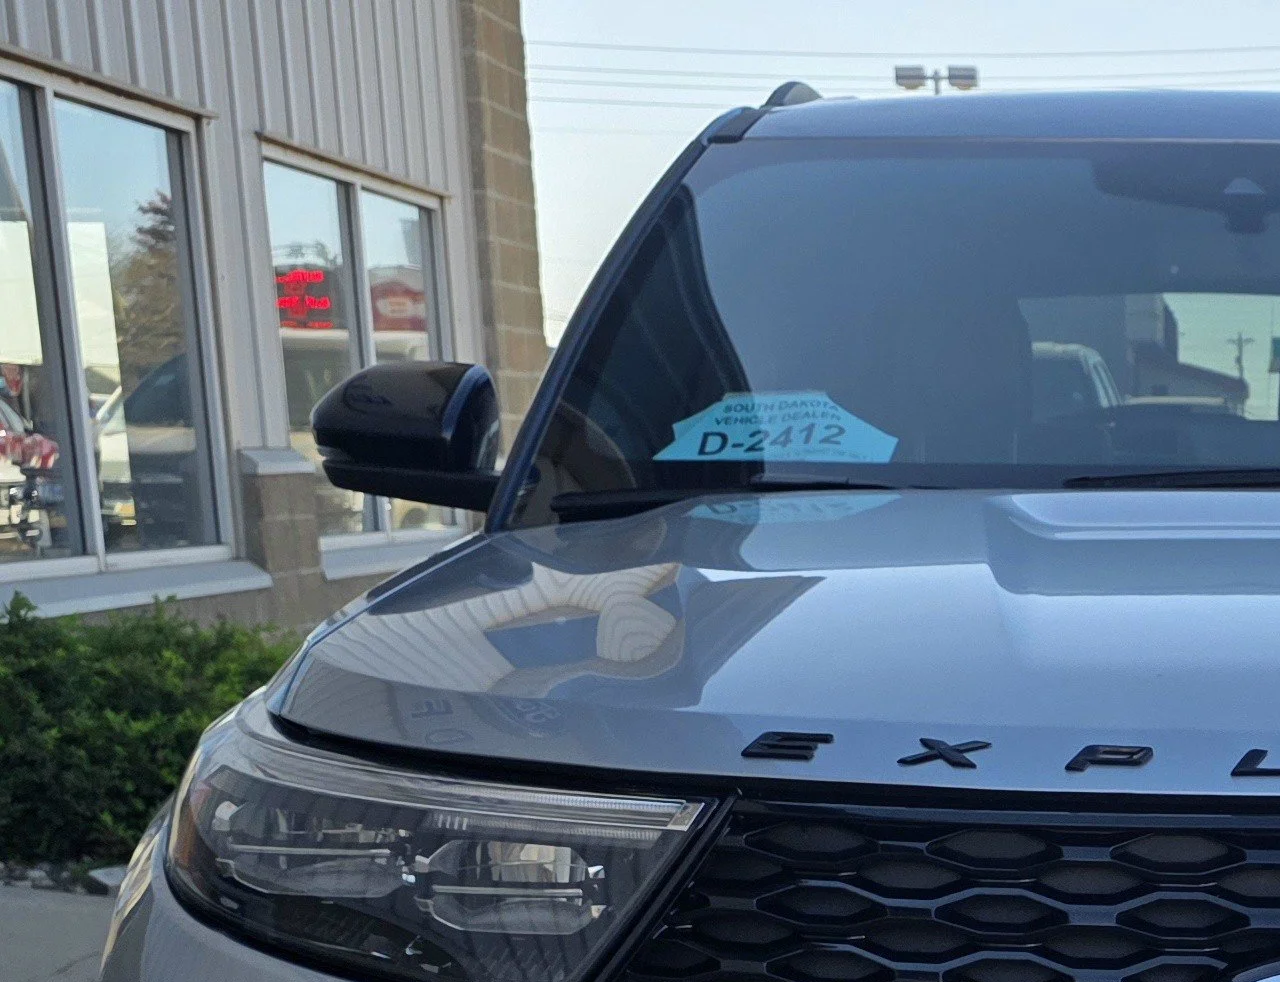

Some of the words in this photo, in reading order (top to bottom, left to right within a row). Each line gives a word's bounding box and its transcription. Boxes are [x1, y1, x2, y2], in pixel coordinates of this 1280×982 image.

[722, 402, 775, 414] SOUTH
[777, 399, 840, 413] DAKOTA
[714, 413, 780, 426] VEHICLE
[781, 409, 842, 423] DEALER
[697, 423, 846, 457] D-2412
